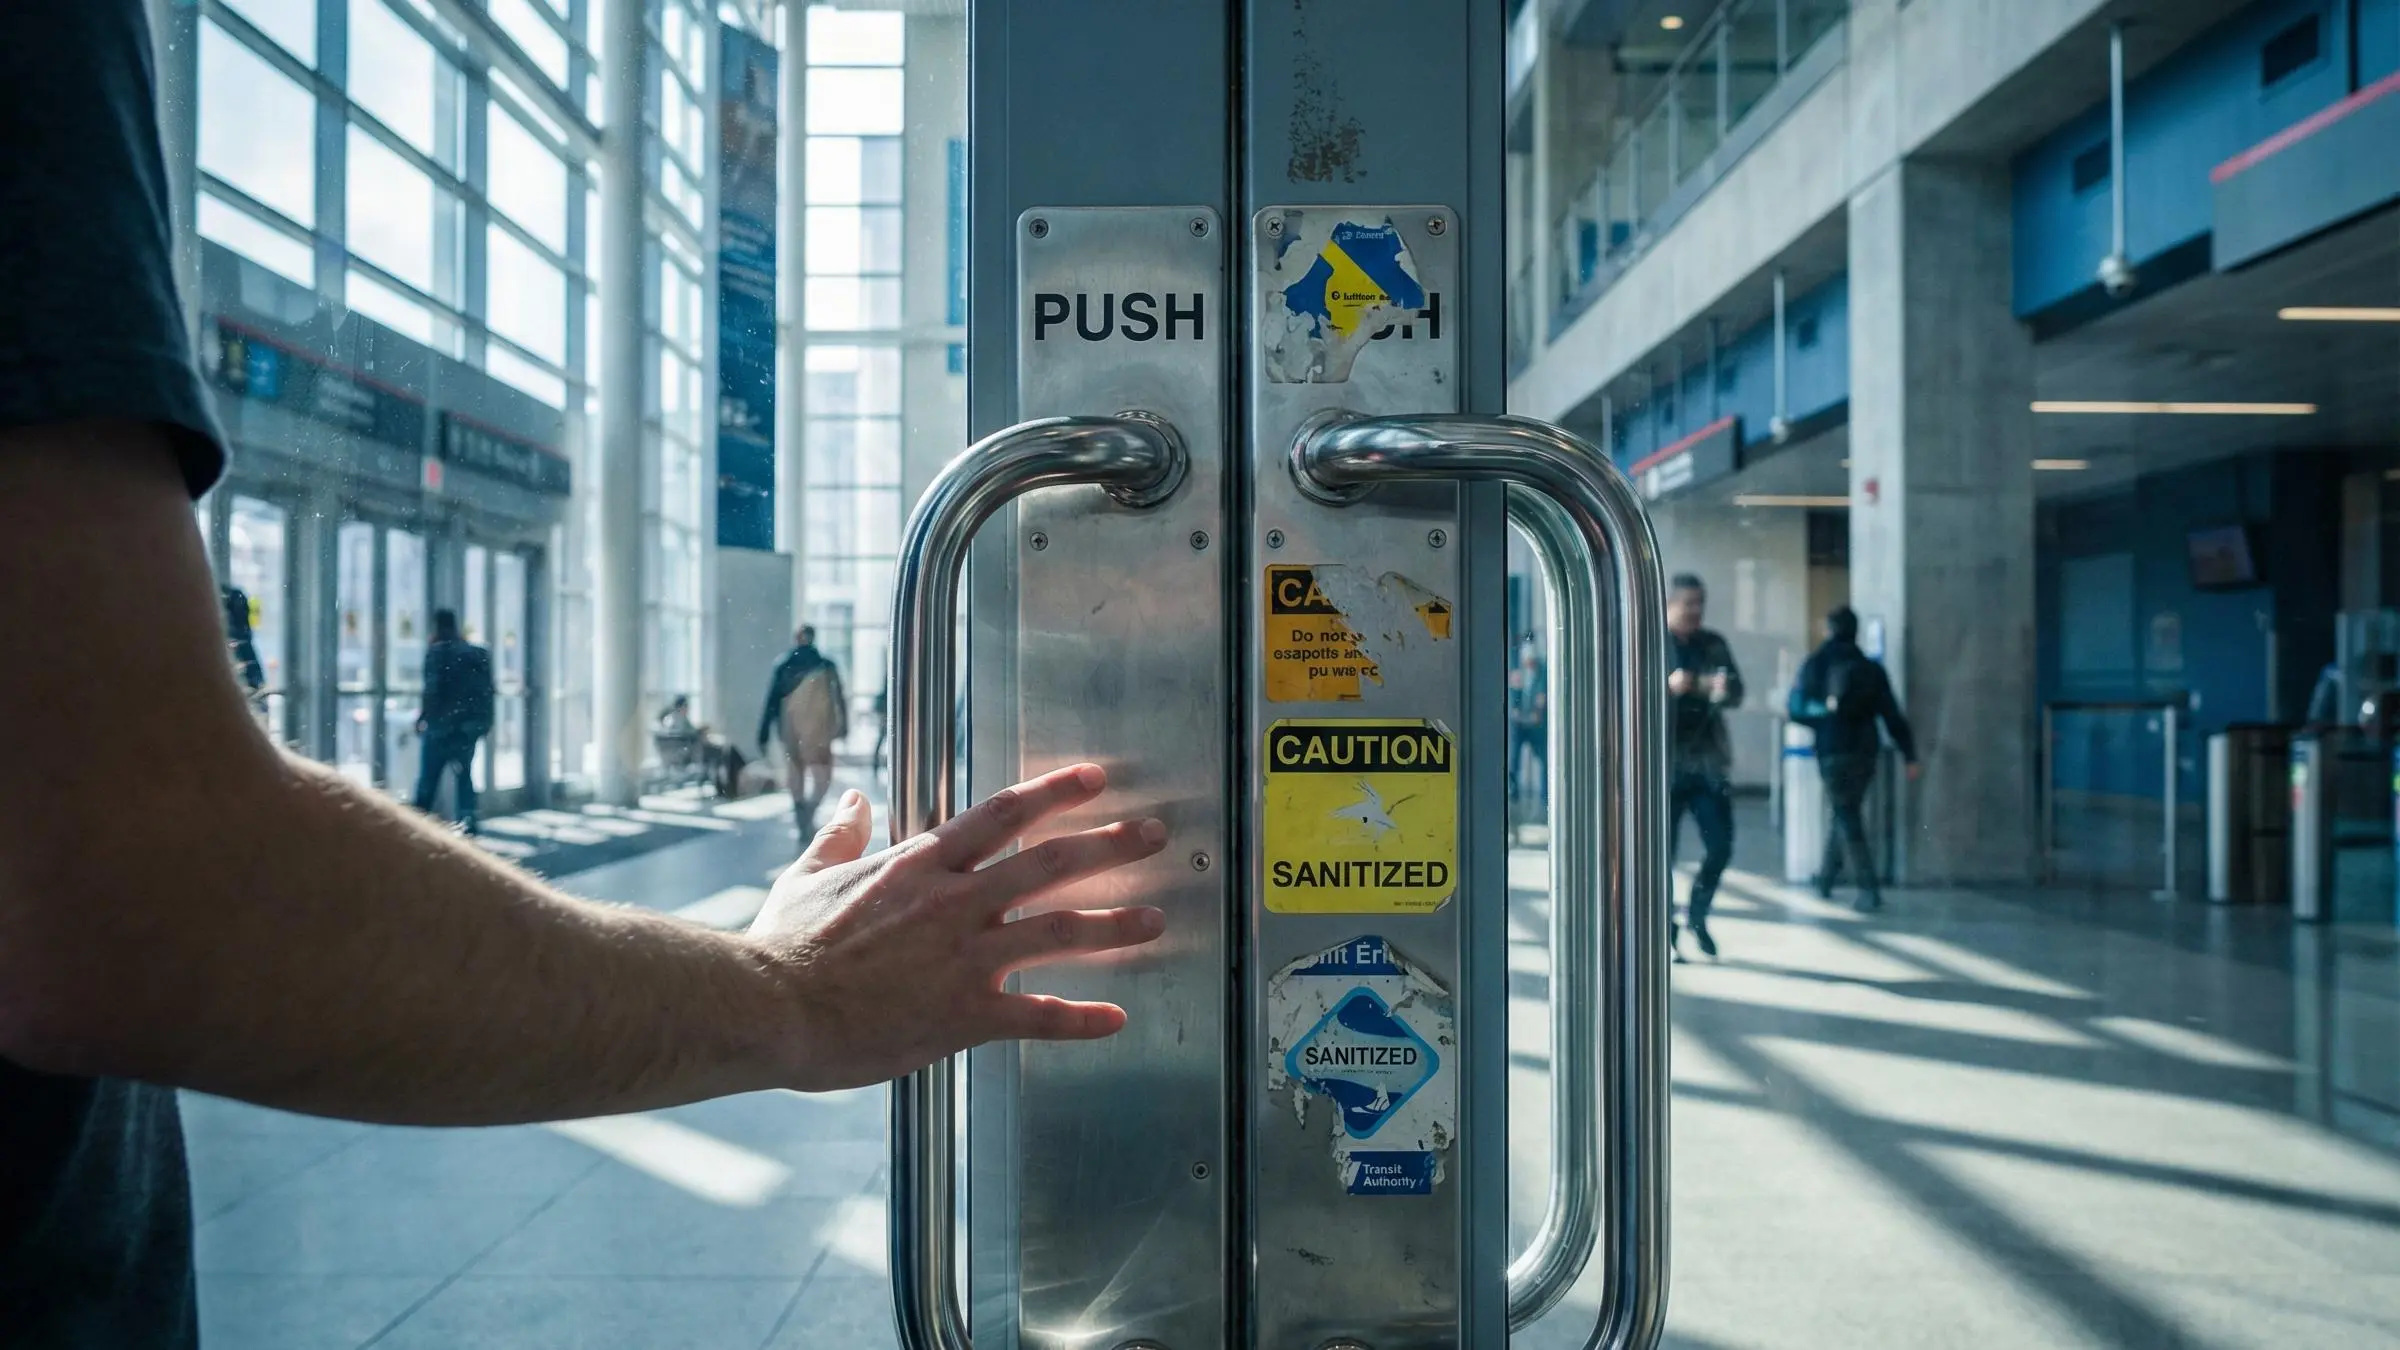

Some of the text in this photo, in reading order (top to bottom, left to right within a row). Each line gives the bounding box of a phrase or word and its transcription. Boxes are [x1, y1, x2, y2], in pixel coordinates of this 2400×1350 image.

[1035, 292, 1204, 342] PUSH
[1292, 630, 1314, 642] Do
[1276, 735, 1444, 765] CAUTION
[1272, 860, 1449, 888] SANITIZED
[1305, 1046, 1417, 1066] SANITIZED
[1362, 1163, 1403, 1175] Transit
